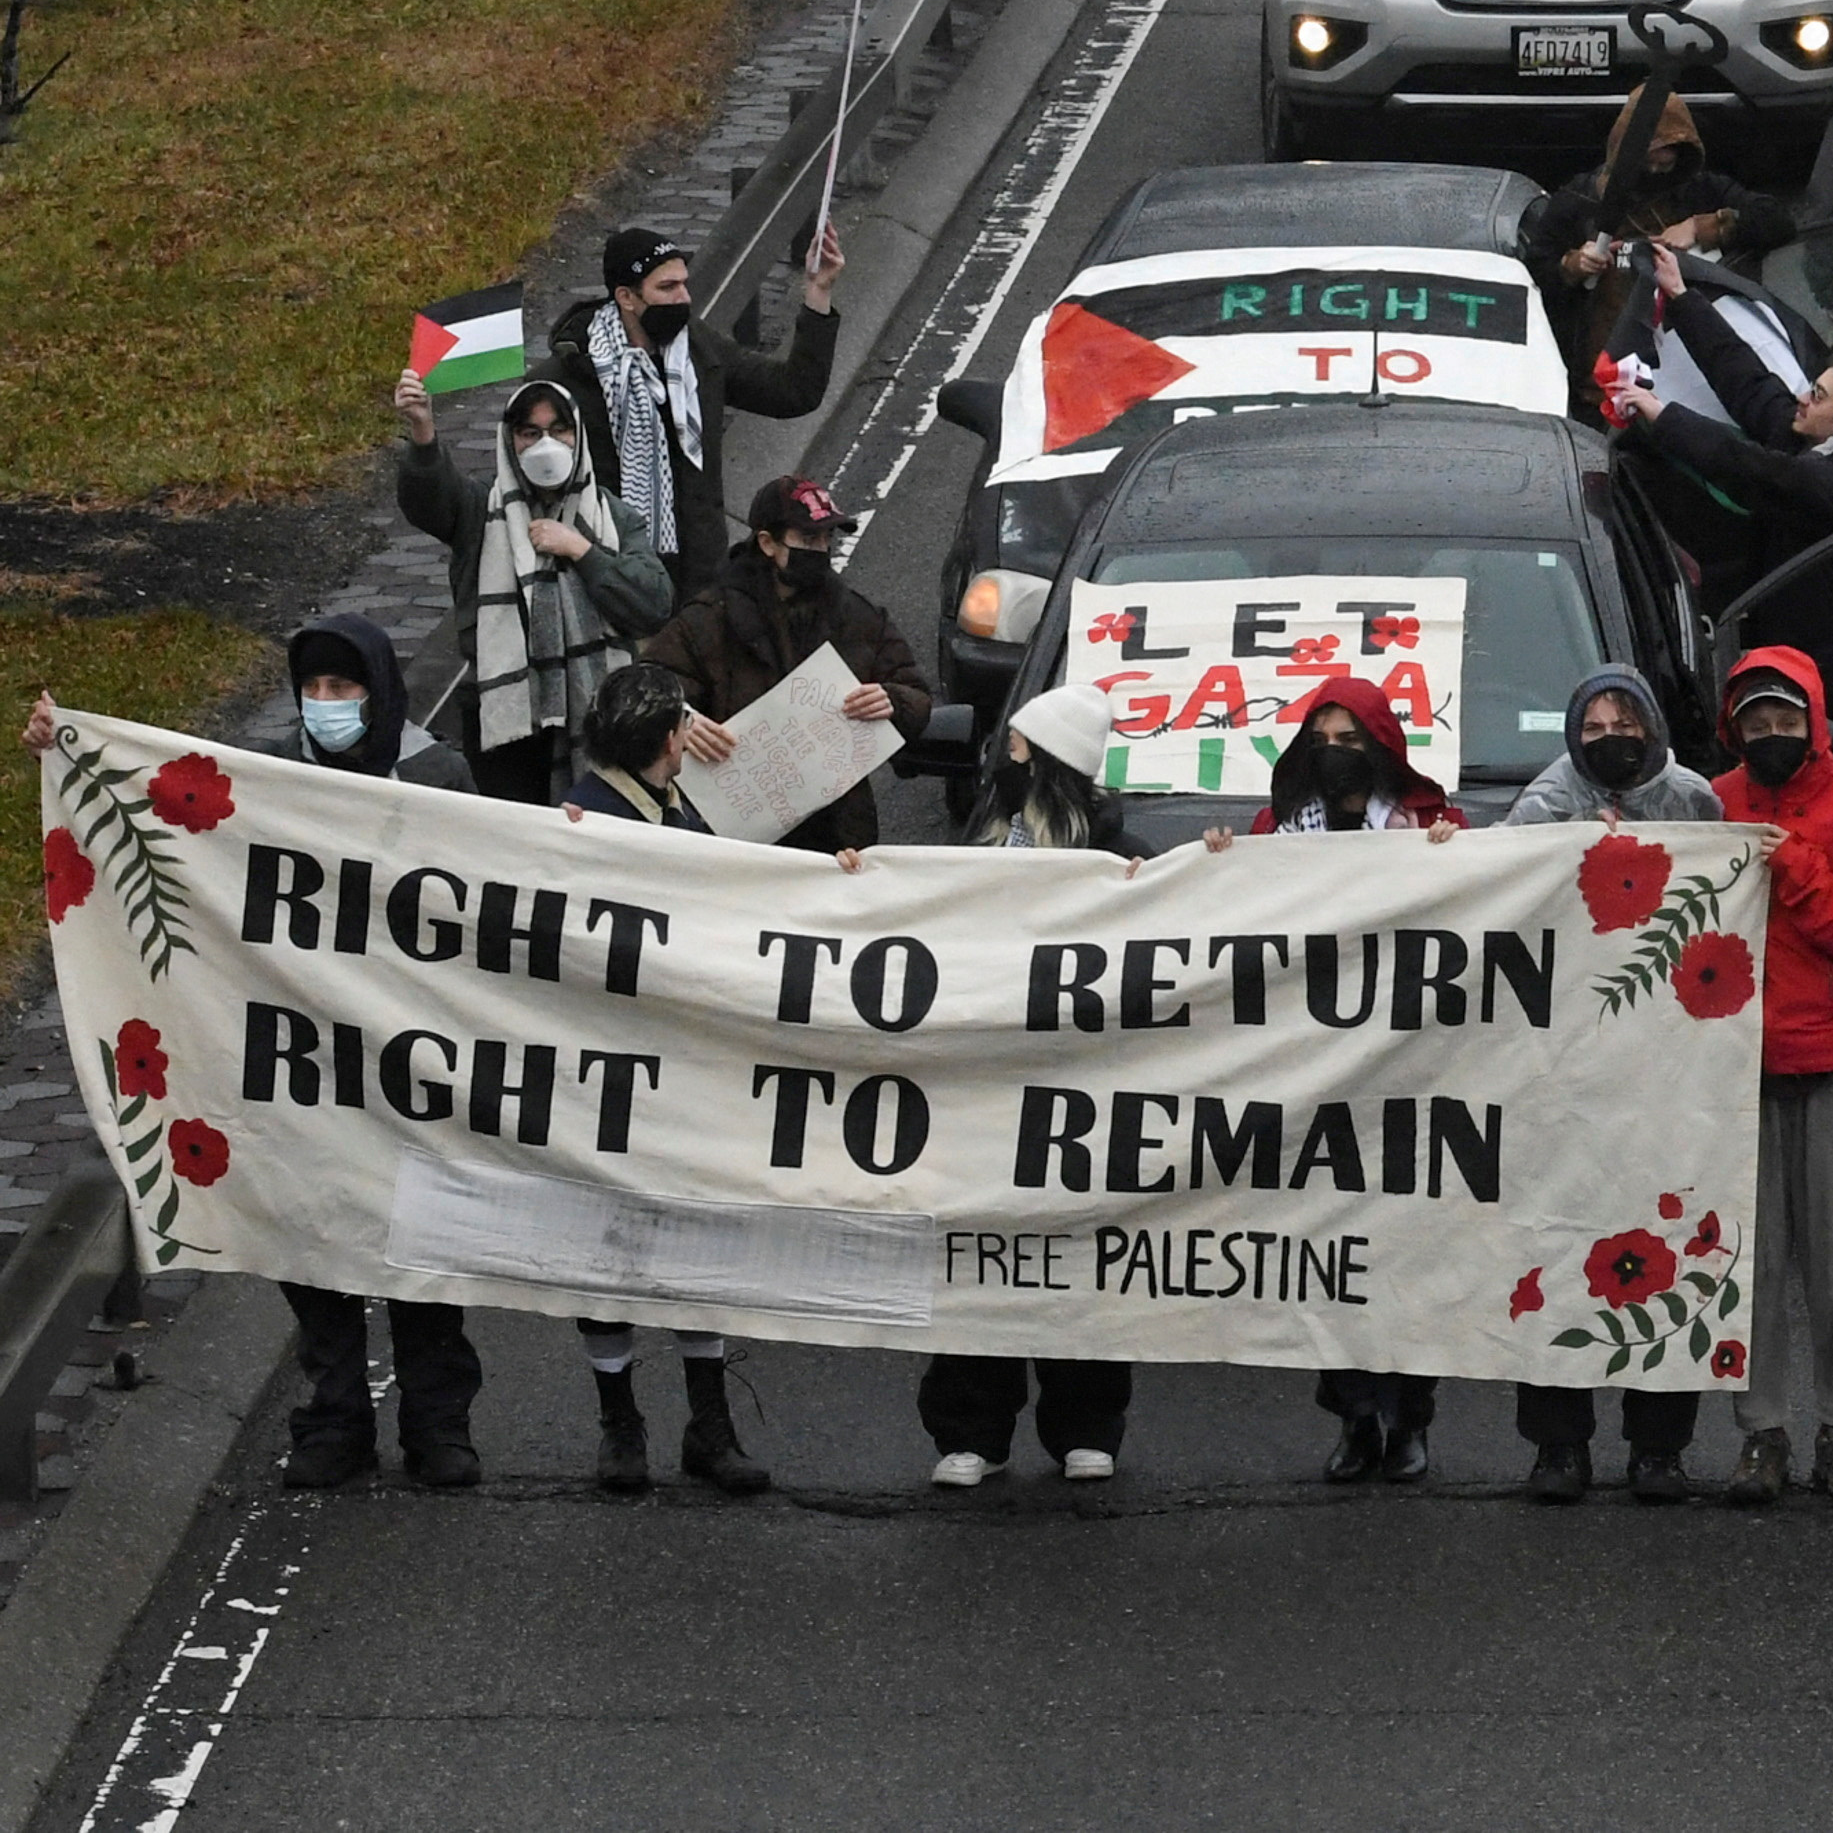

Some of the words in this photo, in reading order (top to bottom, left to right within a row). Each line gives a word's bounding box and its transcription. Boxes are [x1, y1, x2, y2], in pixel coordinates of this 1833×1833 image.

[1220, 282, 1497, 332] RIGHT
[1299, 346, 1432, 384] TO
[1121, 602, 1416, 660] LET
[1092, 662, 1433, 731] GAZA
[750, 721, 805, 788] RIGHT
[781, 718, 816, 759] THE
[1106, 734, 1432, 790] LI
[240, 842, 670, 997] RIGHT
[758, 930, 938, 1033] TO
[1026, 928, 1555, 1032] RETURN
[242, 1000, 660, 1154] RIGHT
[751, 1063, 930, 1176] TO
[1013, 1085, 1502, 1203] REMAIN
[945, 1232, 1072, 1290] FREE
[1095, 1230, 1369, 1305] PALESTINE
